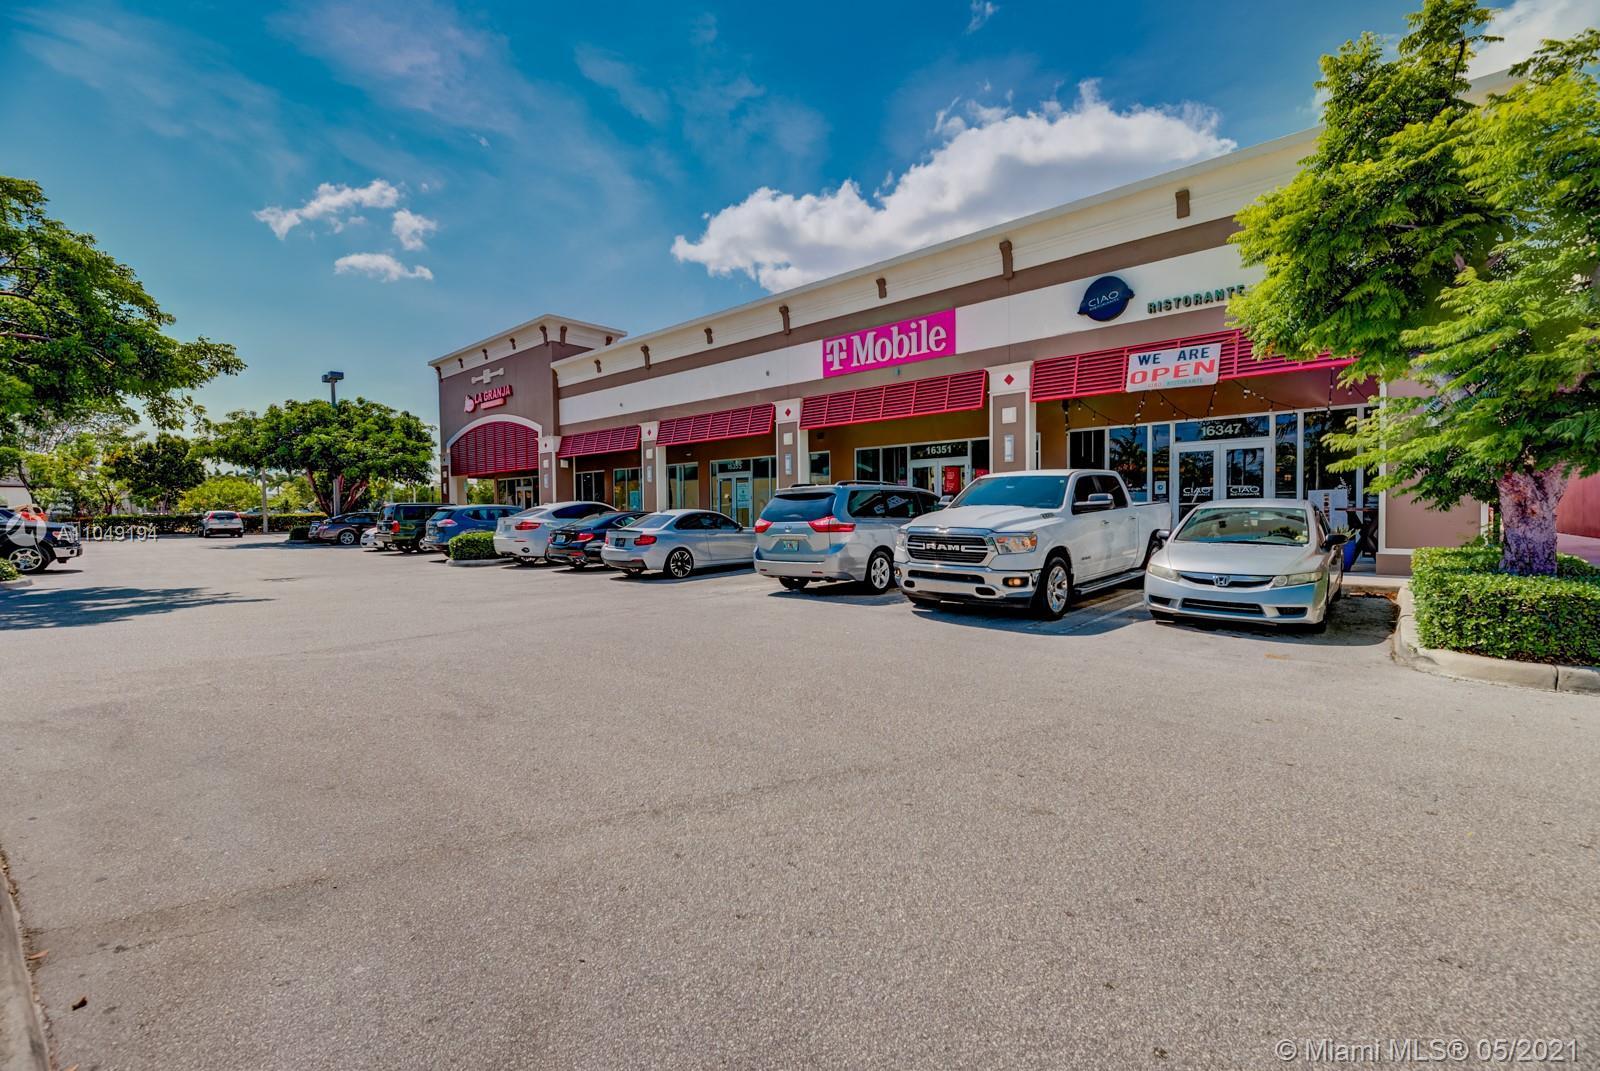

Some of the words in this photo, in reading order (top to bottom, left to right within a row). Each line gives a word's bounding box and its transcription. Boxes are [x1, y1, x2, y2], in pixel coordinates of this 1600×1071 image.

[1088, 290, 1119, 307] CIAO
[1147, 284, 1245, 314] RISTORANTE
[850, 319, 947, 367] Mobile
[1138, 353, 1161, 366] WE
[1177, 346, 1210, 361] ARE
[1130, 359, 1216, 384] OPEN
[474, 392, 484, 404] LA
[483, 385, 511, 401] GRANJA
[1201, 423, 1241, 437] 16347
[926, 445, 952, 455] 16351
[926, 543, 960, 551] RAM
